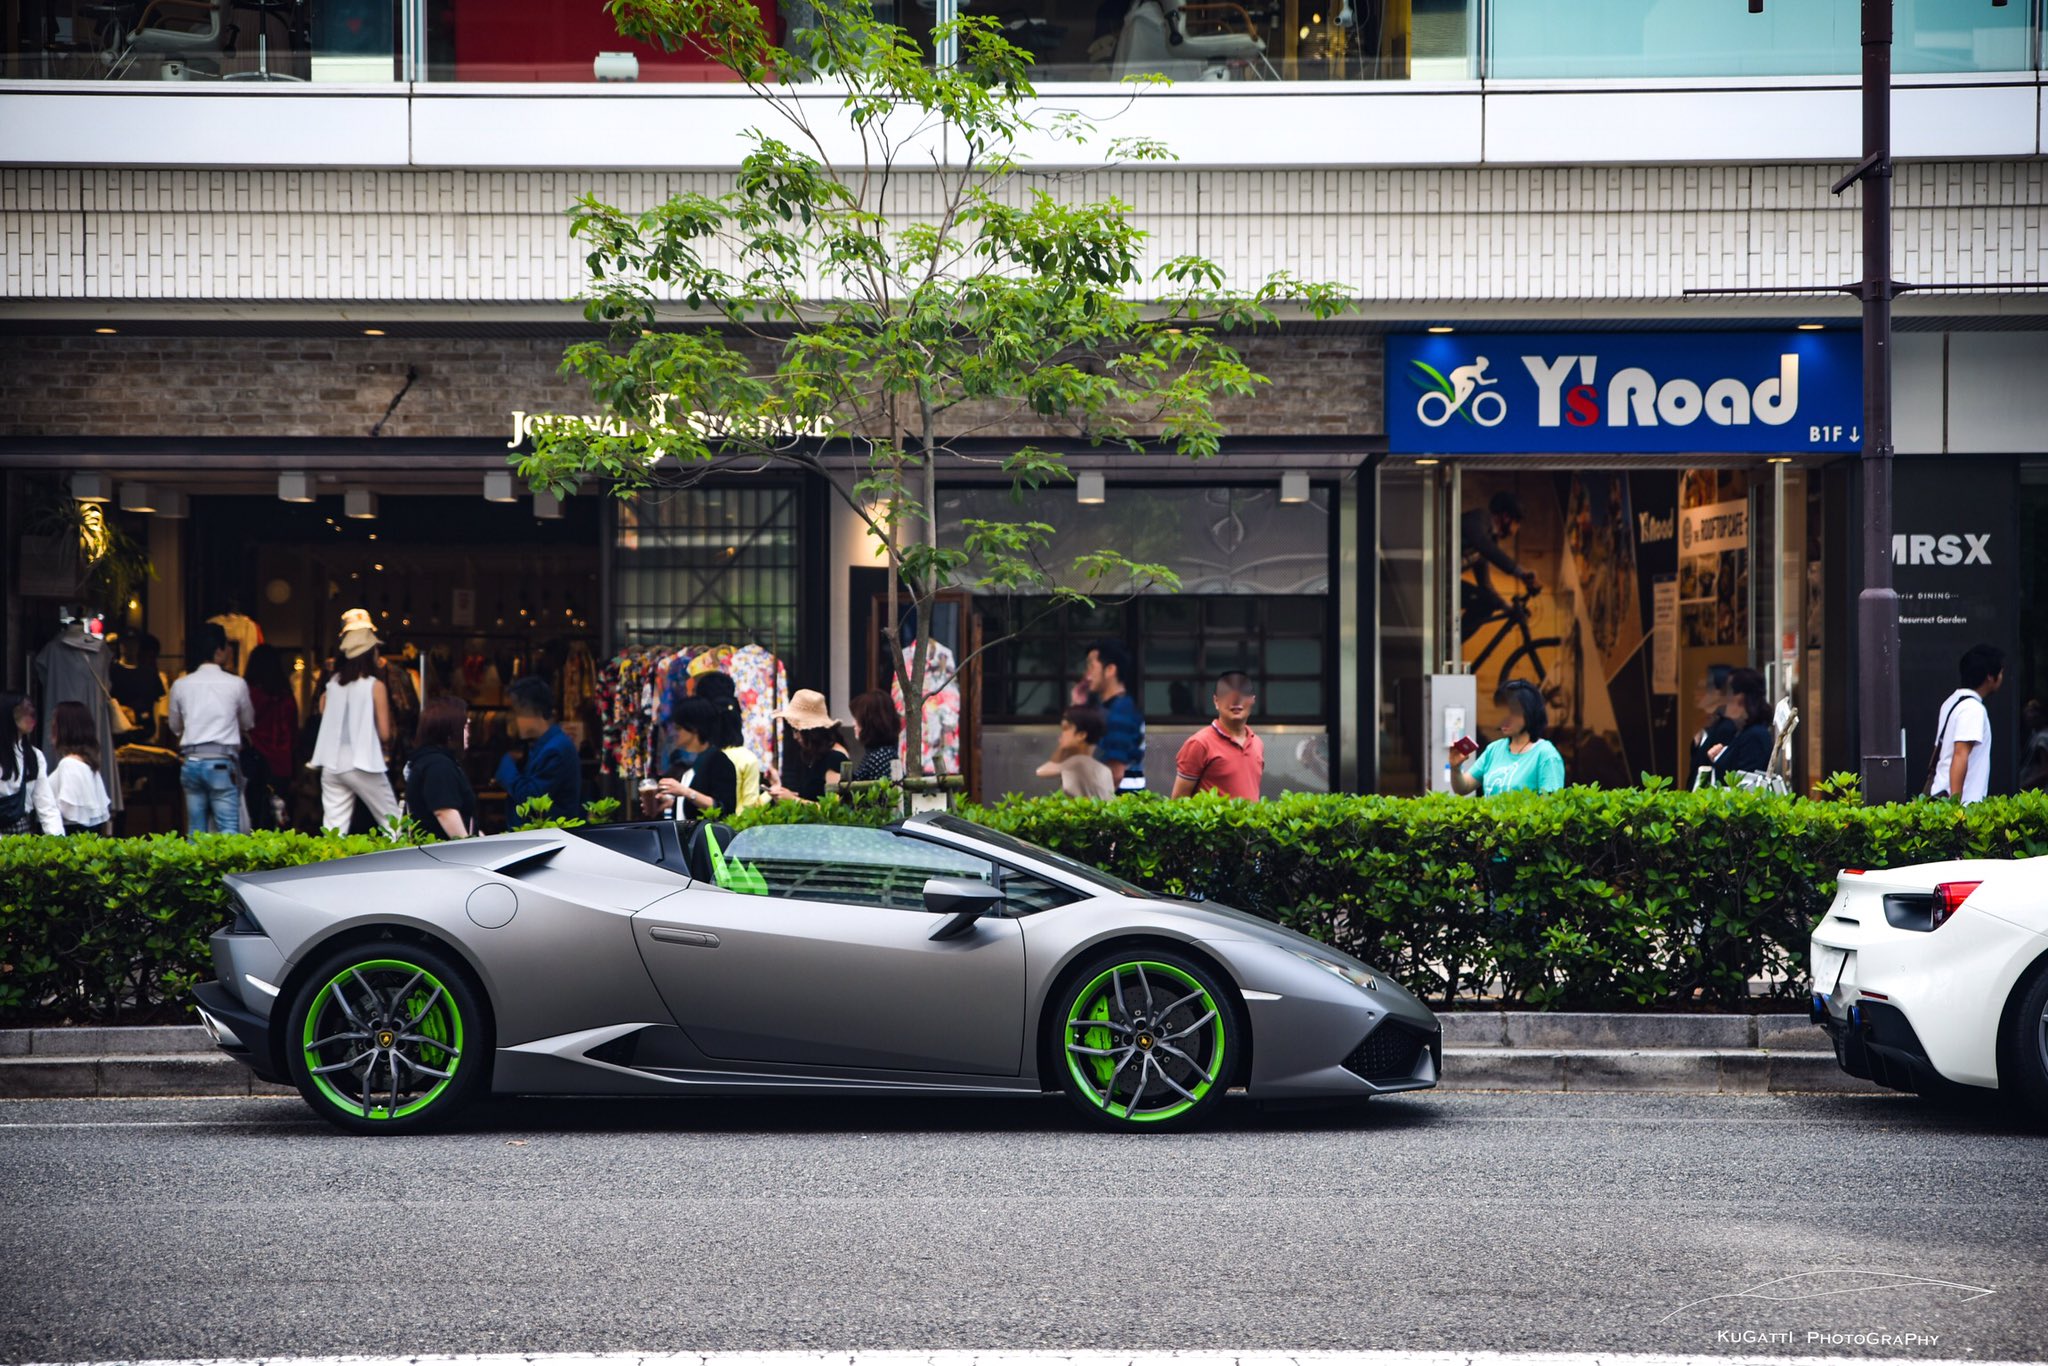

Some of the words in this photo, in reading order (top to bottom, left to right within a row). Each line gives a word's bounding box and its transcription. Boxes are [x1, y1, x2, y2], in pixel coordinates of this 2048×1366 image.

[1607, 353, 1799, 427] Road
[1809, 426, 1842, 442] B1F
[1936, 614, 1967, 624] Garden
